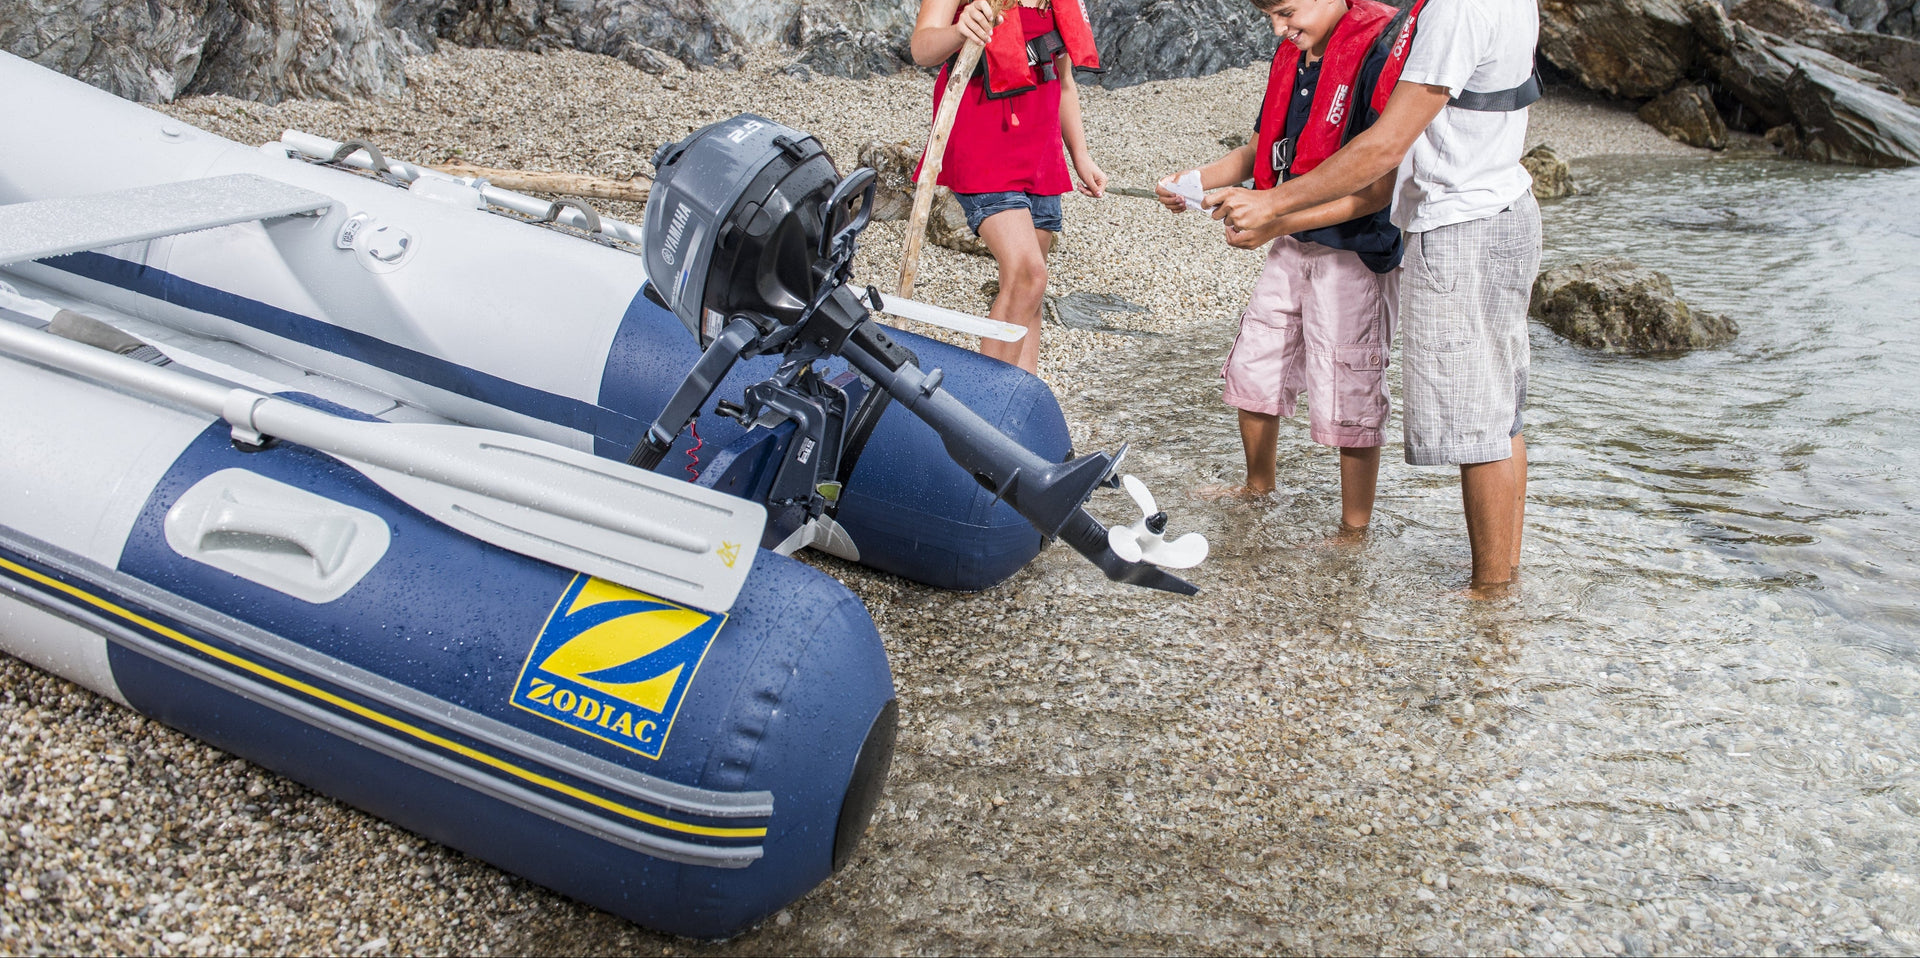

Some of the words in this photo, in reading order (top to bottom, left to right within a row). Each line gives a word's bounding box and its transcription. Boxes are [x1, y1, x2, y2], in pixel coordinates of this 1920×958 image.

[727, 120, 764, 144] 2.5
[664, 202, 691, 254] YAMAHA
[526, 678, 657, 743] ZODIAC
